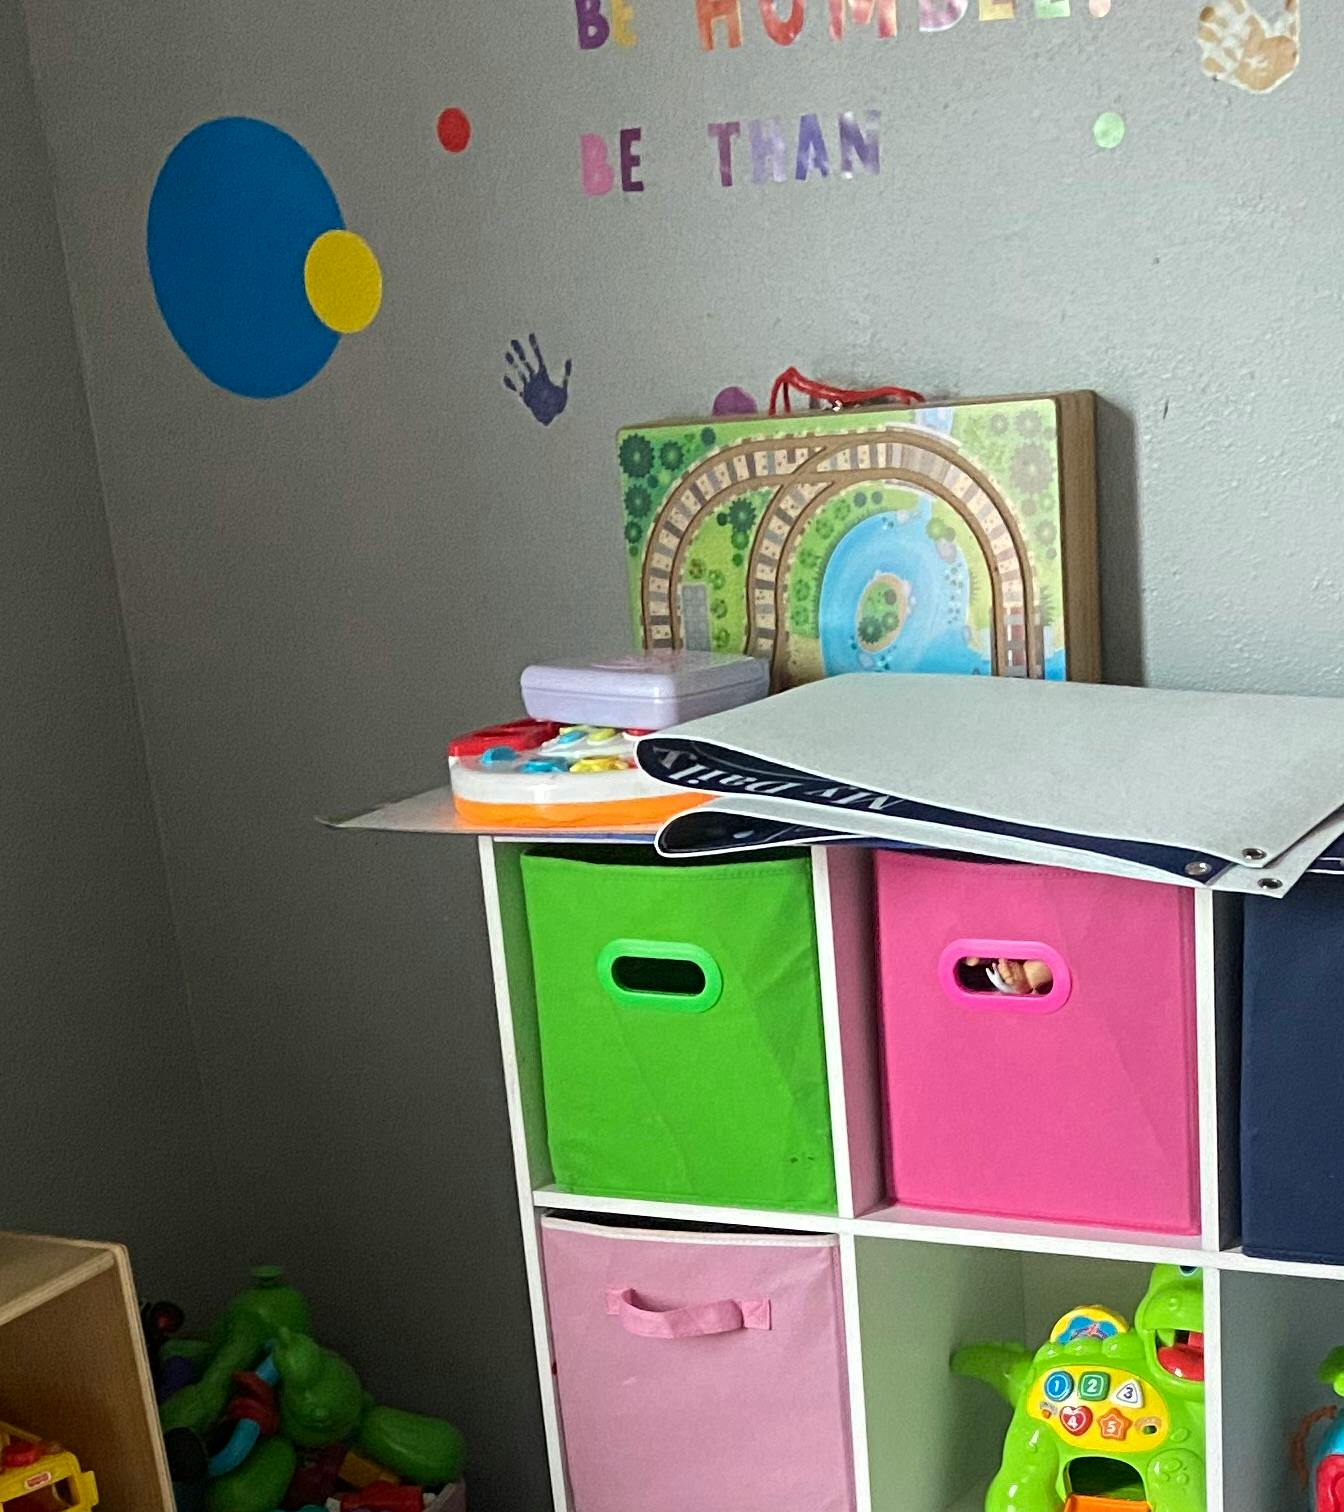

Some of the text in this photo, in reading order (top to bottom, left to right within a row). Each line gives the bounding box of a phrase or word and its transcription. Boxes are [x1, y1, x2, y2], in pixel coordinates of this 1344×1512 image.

[579, 109, 881, 196] BE THAN
[805, 785, 905, 811] My
[1054, 1380, 1060, 1392] 1
[1087, 1378, 1098, 1393] 2
[1123, 1386, 1134, 1399] 3
[1067, 1415, 1079, 1430] 4
[1105, 1421, 1117, 1434] 5
